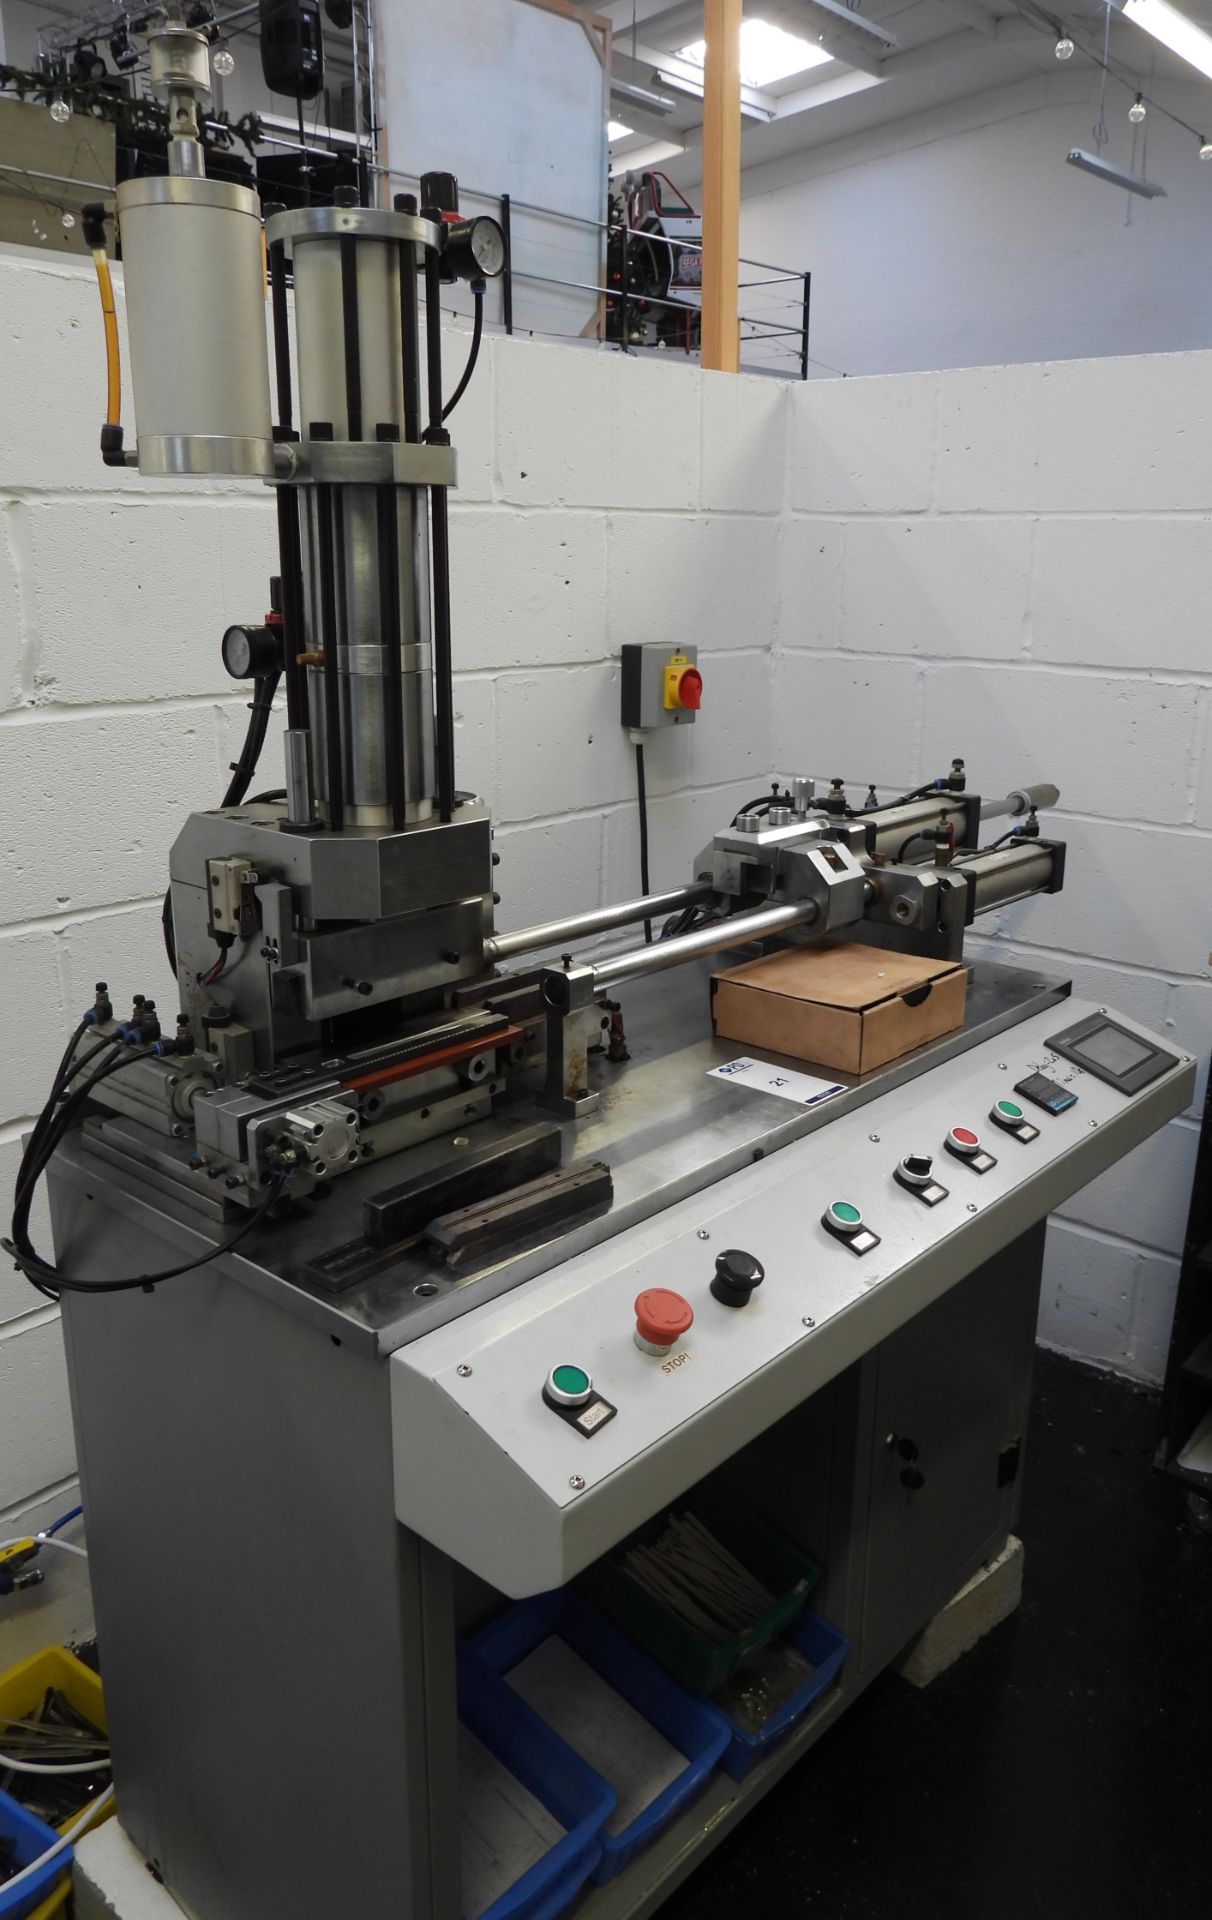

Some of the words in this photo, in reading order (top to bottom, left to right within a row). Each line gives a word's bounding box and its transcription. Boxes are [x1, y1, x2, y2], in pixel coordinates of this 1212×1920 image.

[769, 1077, 789, 1087] 21
[661, 1352, 691, 1374] STOP!
[583, 1407, 606, 1426] Start
